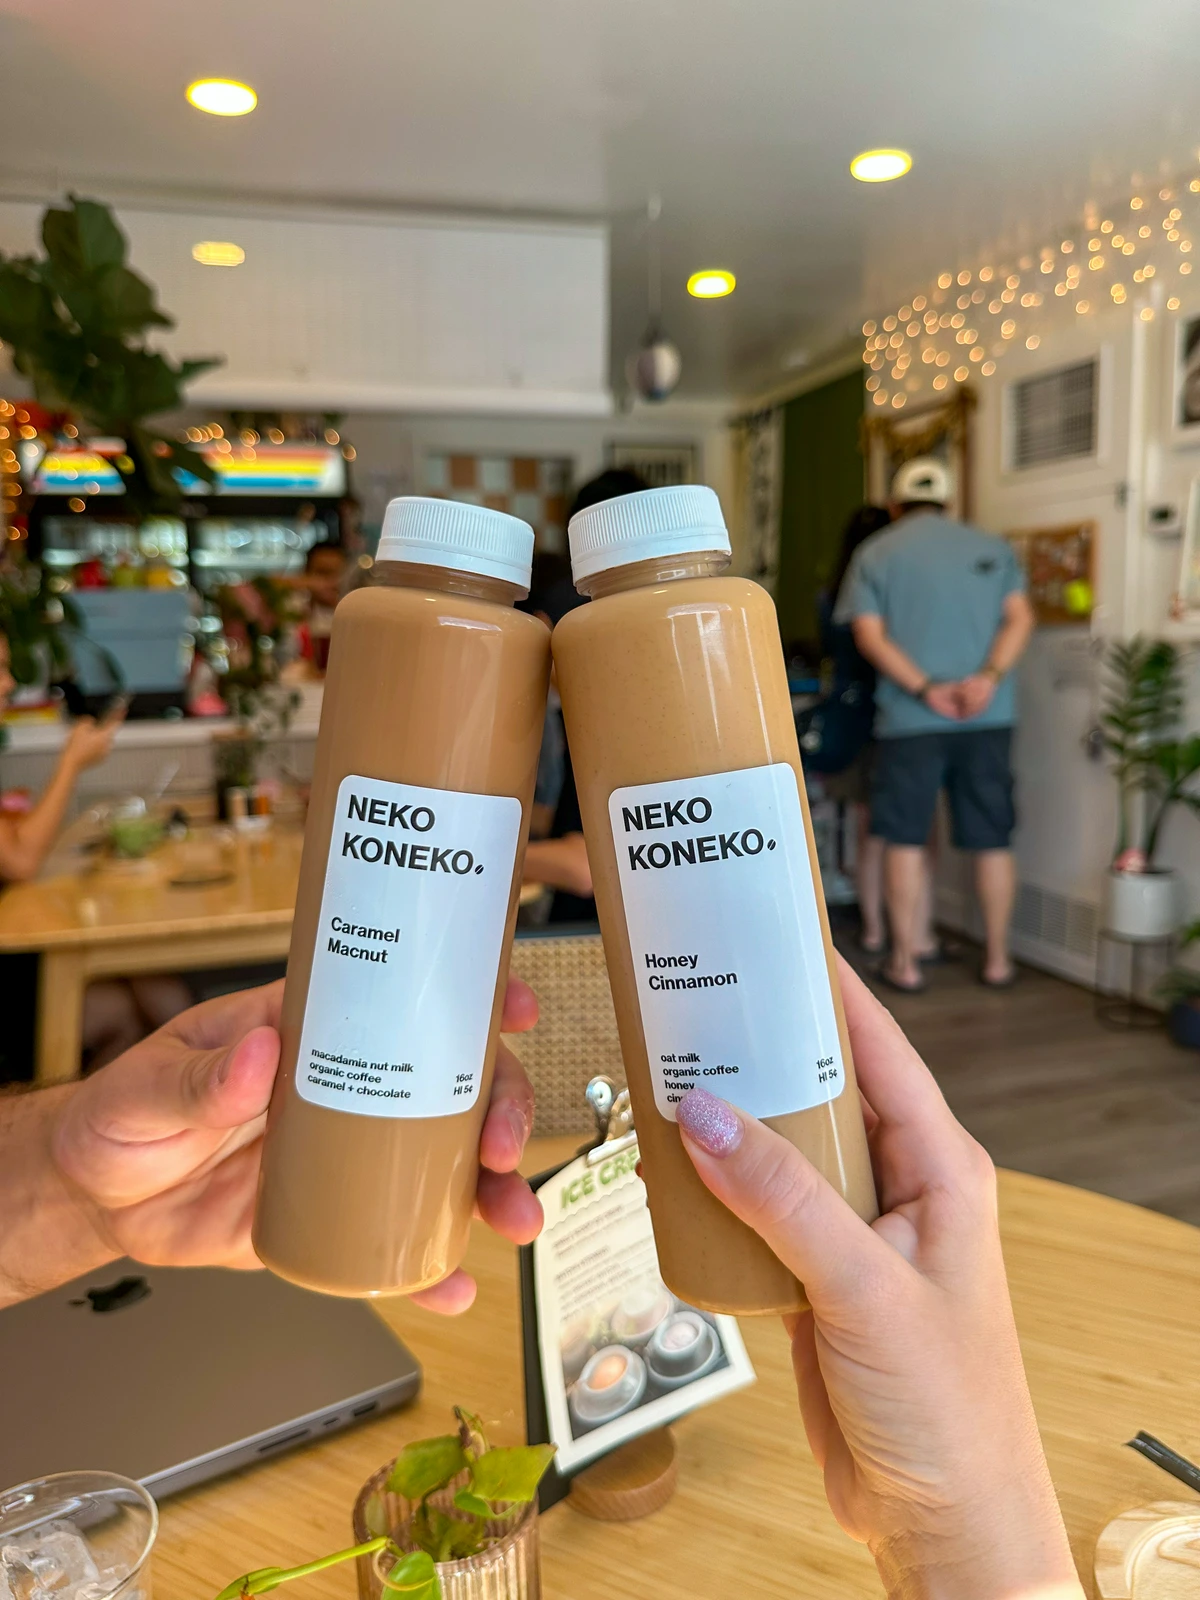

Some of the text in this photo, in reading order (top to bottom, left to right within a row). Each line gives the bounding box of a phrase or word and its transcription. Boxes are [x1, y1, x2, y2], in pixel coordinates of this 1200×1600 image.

[347, 794, 436, 832] NEKO
[621, 796, 713, 832] NEKO
[341, 832, 474, 875] KONEKO
[627, 828, 764, 871] KONEKO
[331, 917, 400, 943] Caramel
[327, 937, 388, 963] Macnut
[645, 952, 698, 970] Honey
[648, 972, 738, 991] Cinnamon
[311, 1048, 414, 1073] macadamia nut milk
[660, 1052, 701, 1063] oat milk
[816, 1056, 834, 1069] 16oz
[309, 1061, 382, 1083] organic coffee
[455, 1073, 474, 1083] 16oz
[663, 1064, 739, 1078] organic coffee
[818, 1071, 828, 1083] HI
[307, 1074, 346, 1091] caramel
[356, 1086, 411, 1099] chocolate
[453, 1085, 463, 1096] HI
[667, 1093, 683, 1103] cin
[561, 1170, 595, 1210] ICE
